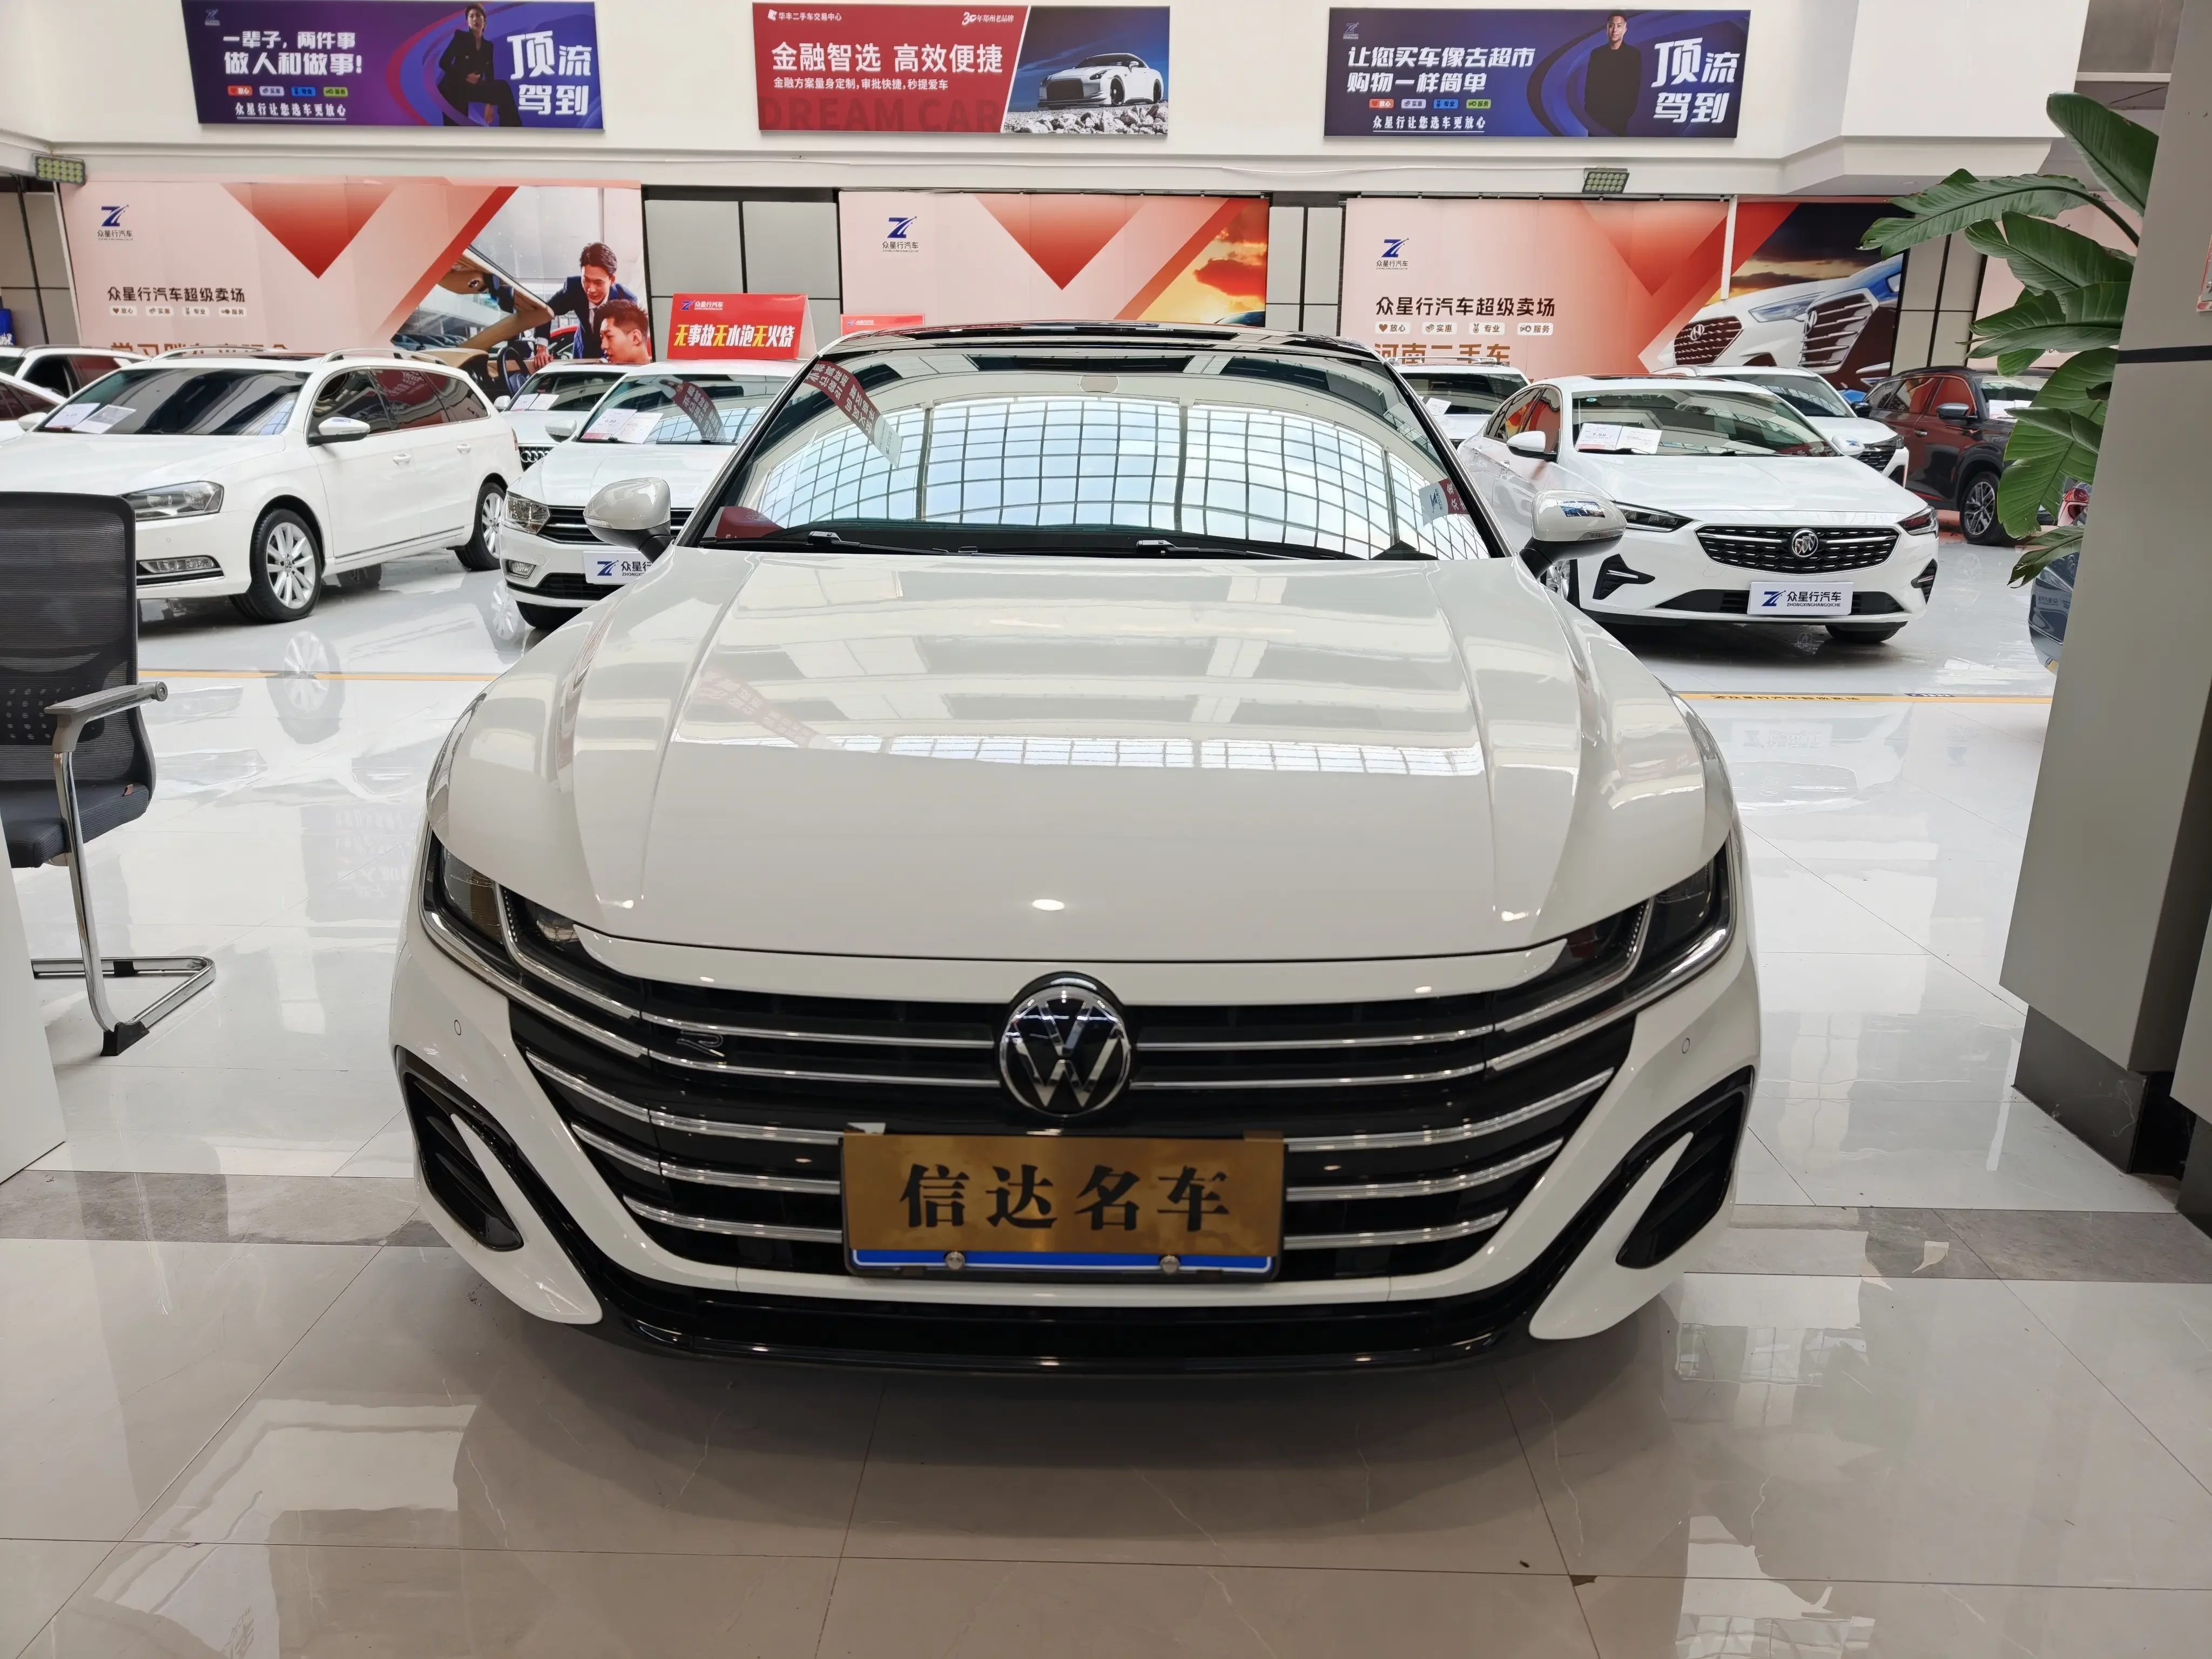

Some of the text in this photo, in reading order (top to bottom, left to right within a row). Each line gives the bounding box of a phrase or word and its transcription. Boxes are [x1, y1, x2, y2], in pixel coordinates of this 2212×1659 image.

[778, 12, 842, 22] 华丰二手车交易中心
[223, 31, 355, 49] 一辈子，两件事
[224, 51, 362, 76] 做人和做事！
[507, 30, 592, 80] 顶流
[771, 42, 1003, 73] 金融智选 高效便捷
[1348, 46, 1536, 68] 让您买车像去超市
[1651, 37, 1740, 87] 顶流
[1346, 72, 1487, 93] 购物一样简单
[235, 102, 346, 116] 众星行让您选车更放心
[518, 84, 589, 116] 驾到
[1653, 92, 1730, 123] 驾到
[759, 96, 1000, 132] DREAM CAR
[1373, 116, 1486, 129] 众星行让您选车更放心
[107, 287, 245, 302] 众星行汽车超级卖场
[1376, 296, 1555, 316] 众星行汽车超级卖场
[673, 324, 795, 347] 无事故无水泡无火烧
[1390, 324, 1550, 333] 放心 实惠 专业 服务
[1787, 591, 1842, 602] 众星行汽车
[900, 1164, 1230, 1232] 信达名车
